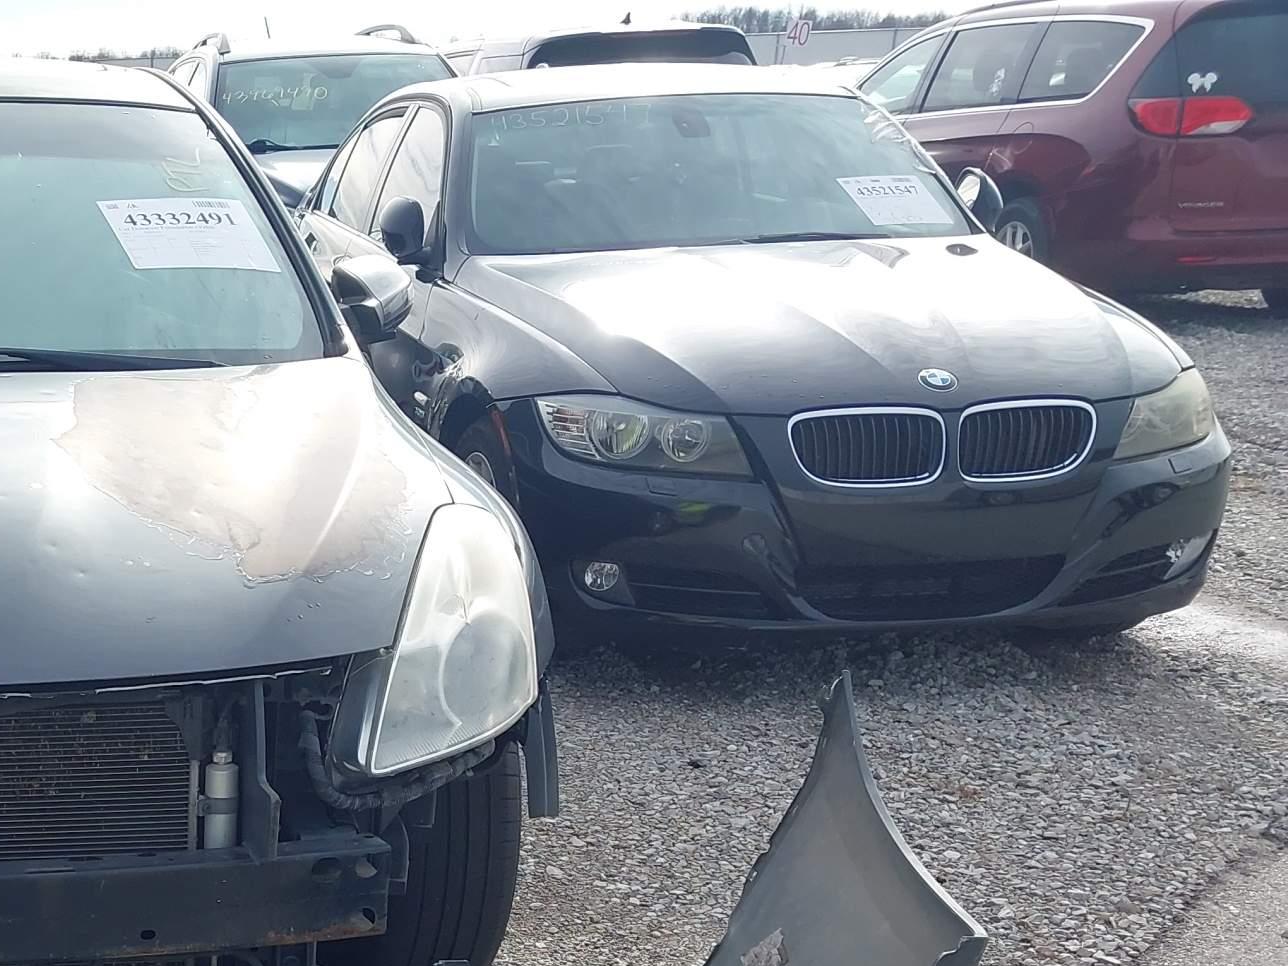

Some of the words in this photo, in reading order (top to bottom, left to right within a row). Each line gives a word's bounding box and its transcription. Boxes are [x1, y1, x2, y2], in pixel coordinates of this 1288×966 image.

[787, 21, 810, 46] 40
[856, 185, 919, 197] 43521547
[123, 211, 238, 227] 43332491
